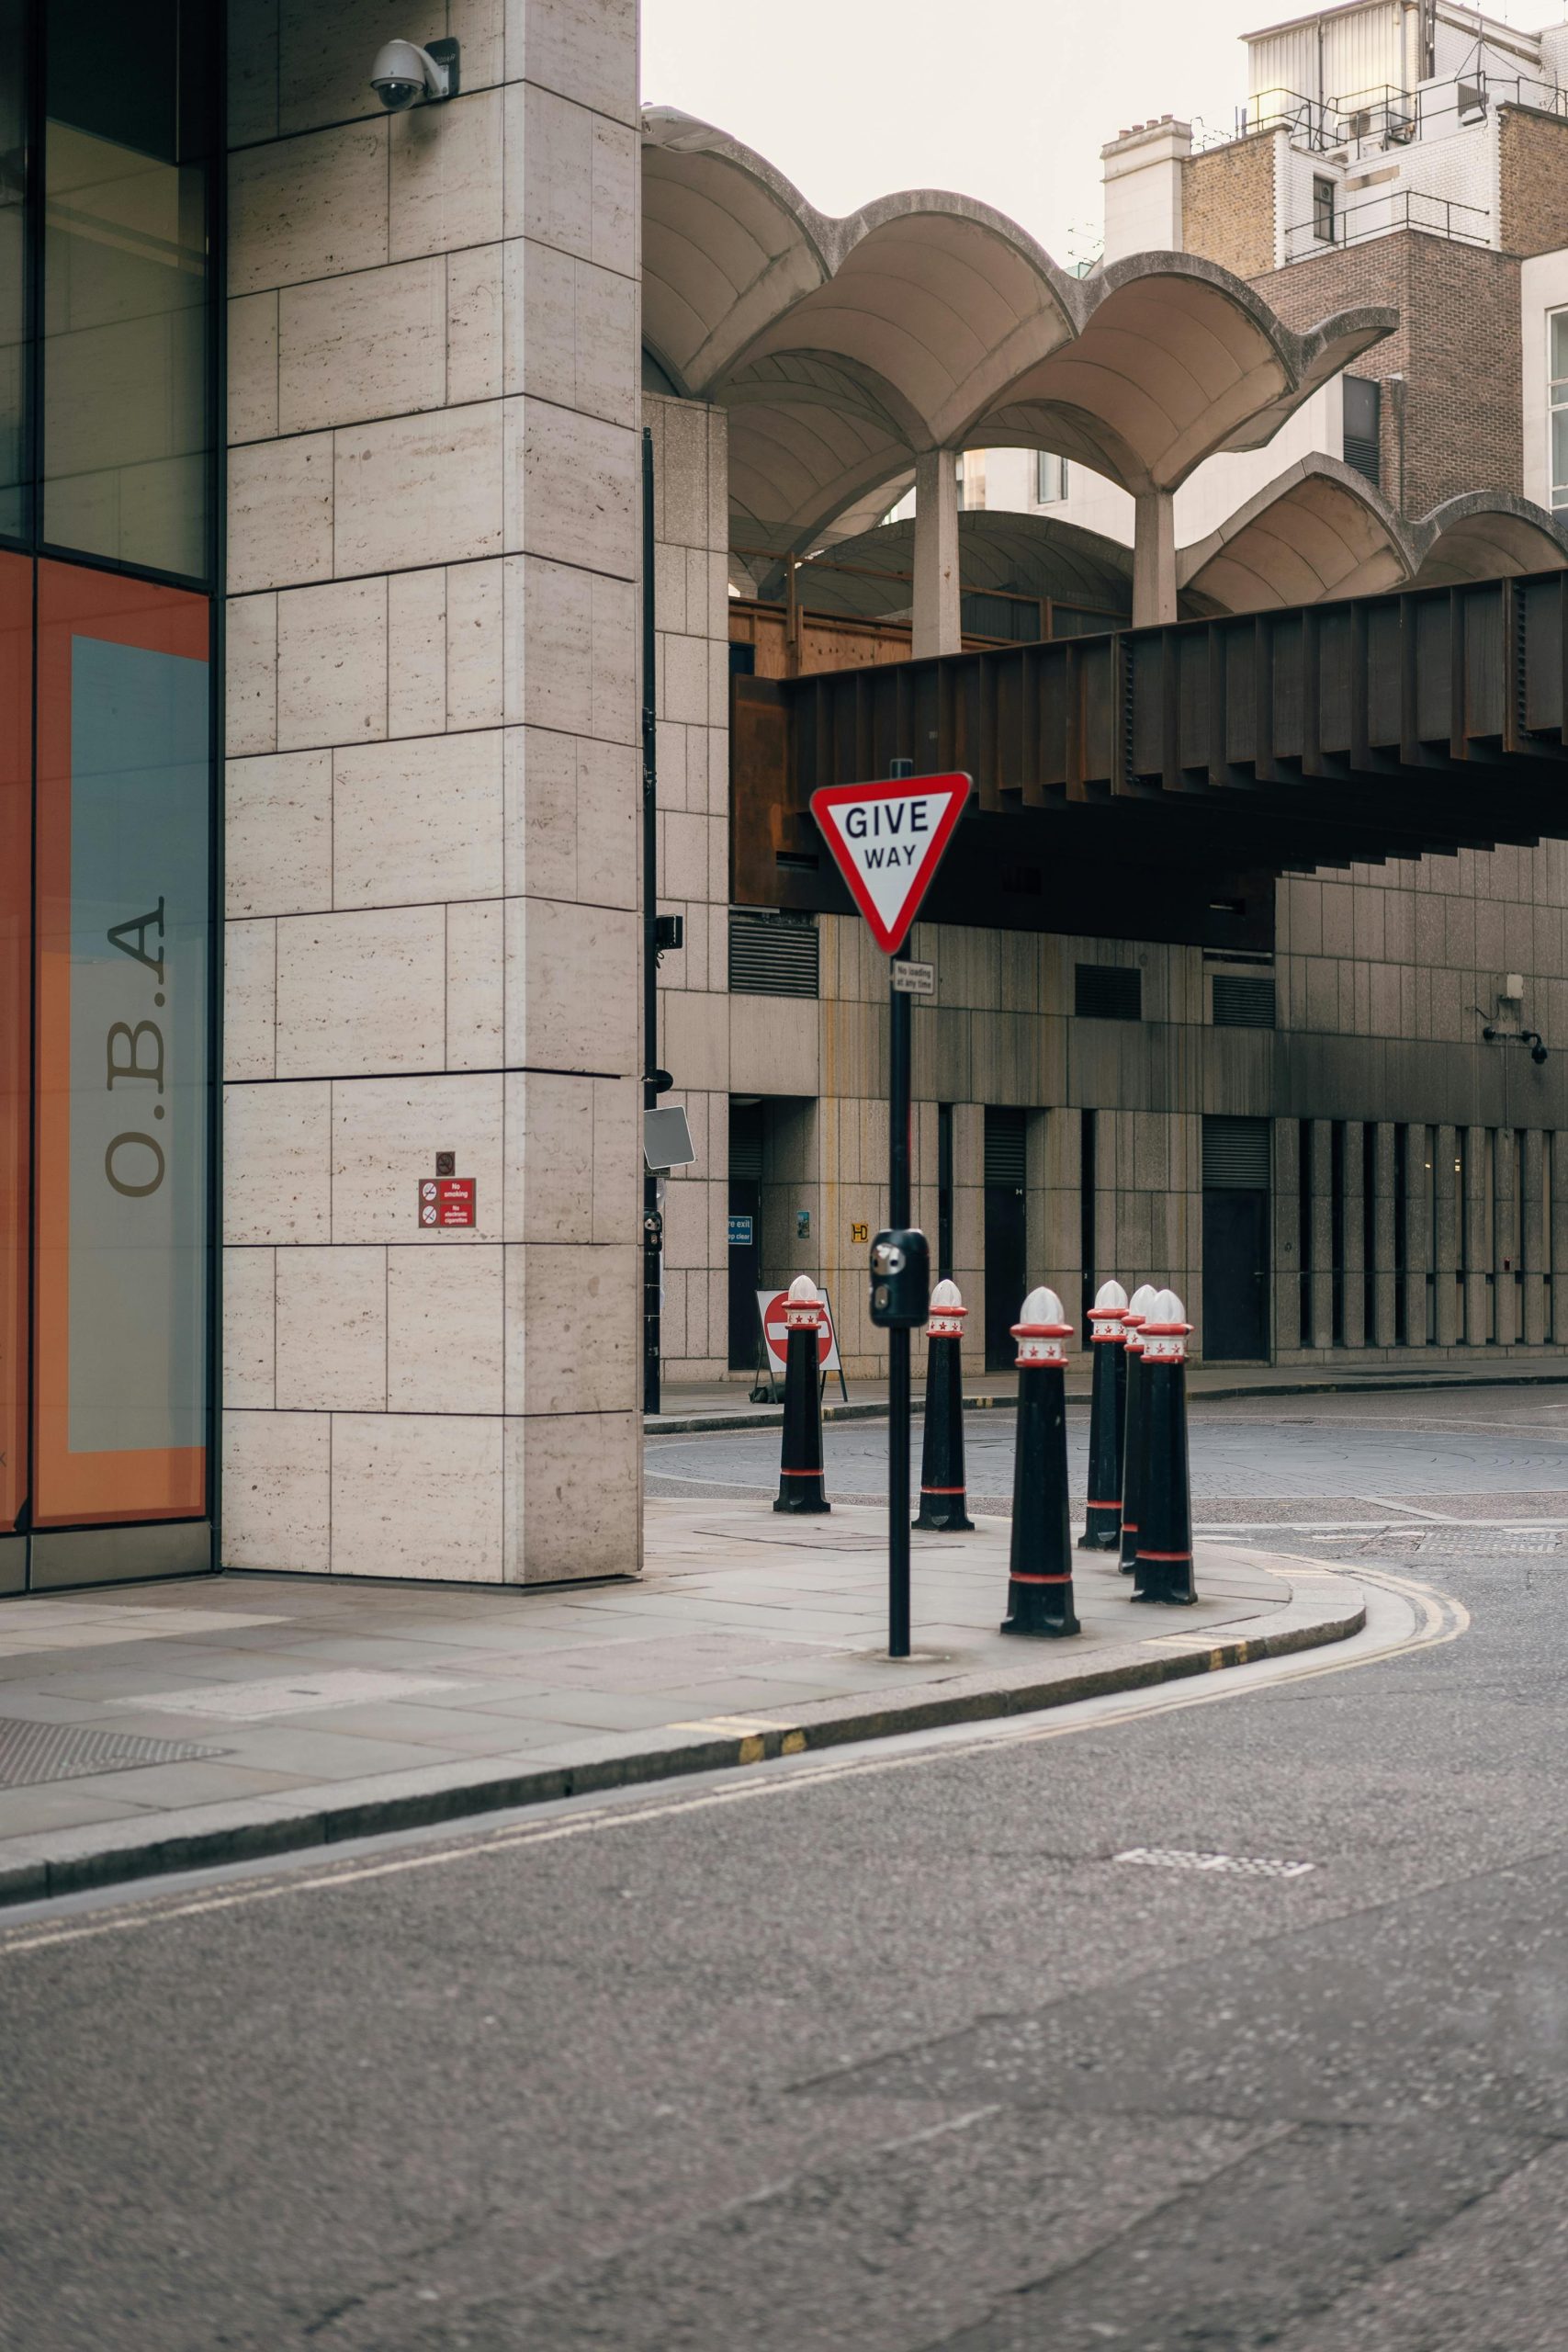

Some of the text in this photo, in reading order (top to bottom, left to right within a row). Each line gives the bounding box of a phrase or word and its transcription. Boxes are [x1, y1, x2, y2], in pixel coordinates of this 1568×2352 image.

[845, 800, 929, 840] GIVE
[864, 844, 916, 870] WAY
[897, 966, 931, 979] No loading
[897, 978, 931, 989] at any time
[105, 895, 166, 1198] O.B.A
